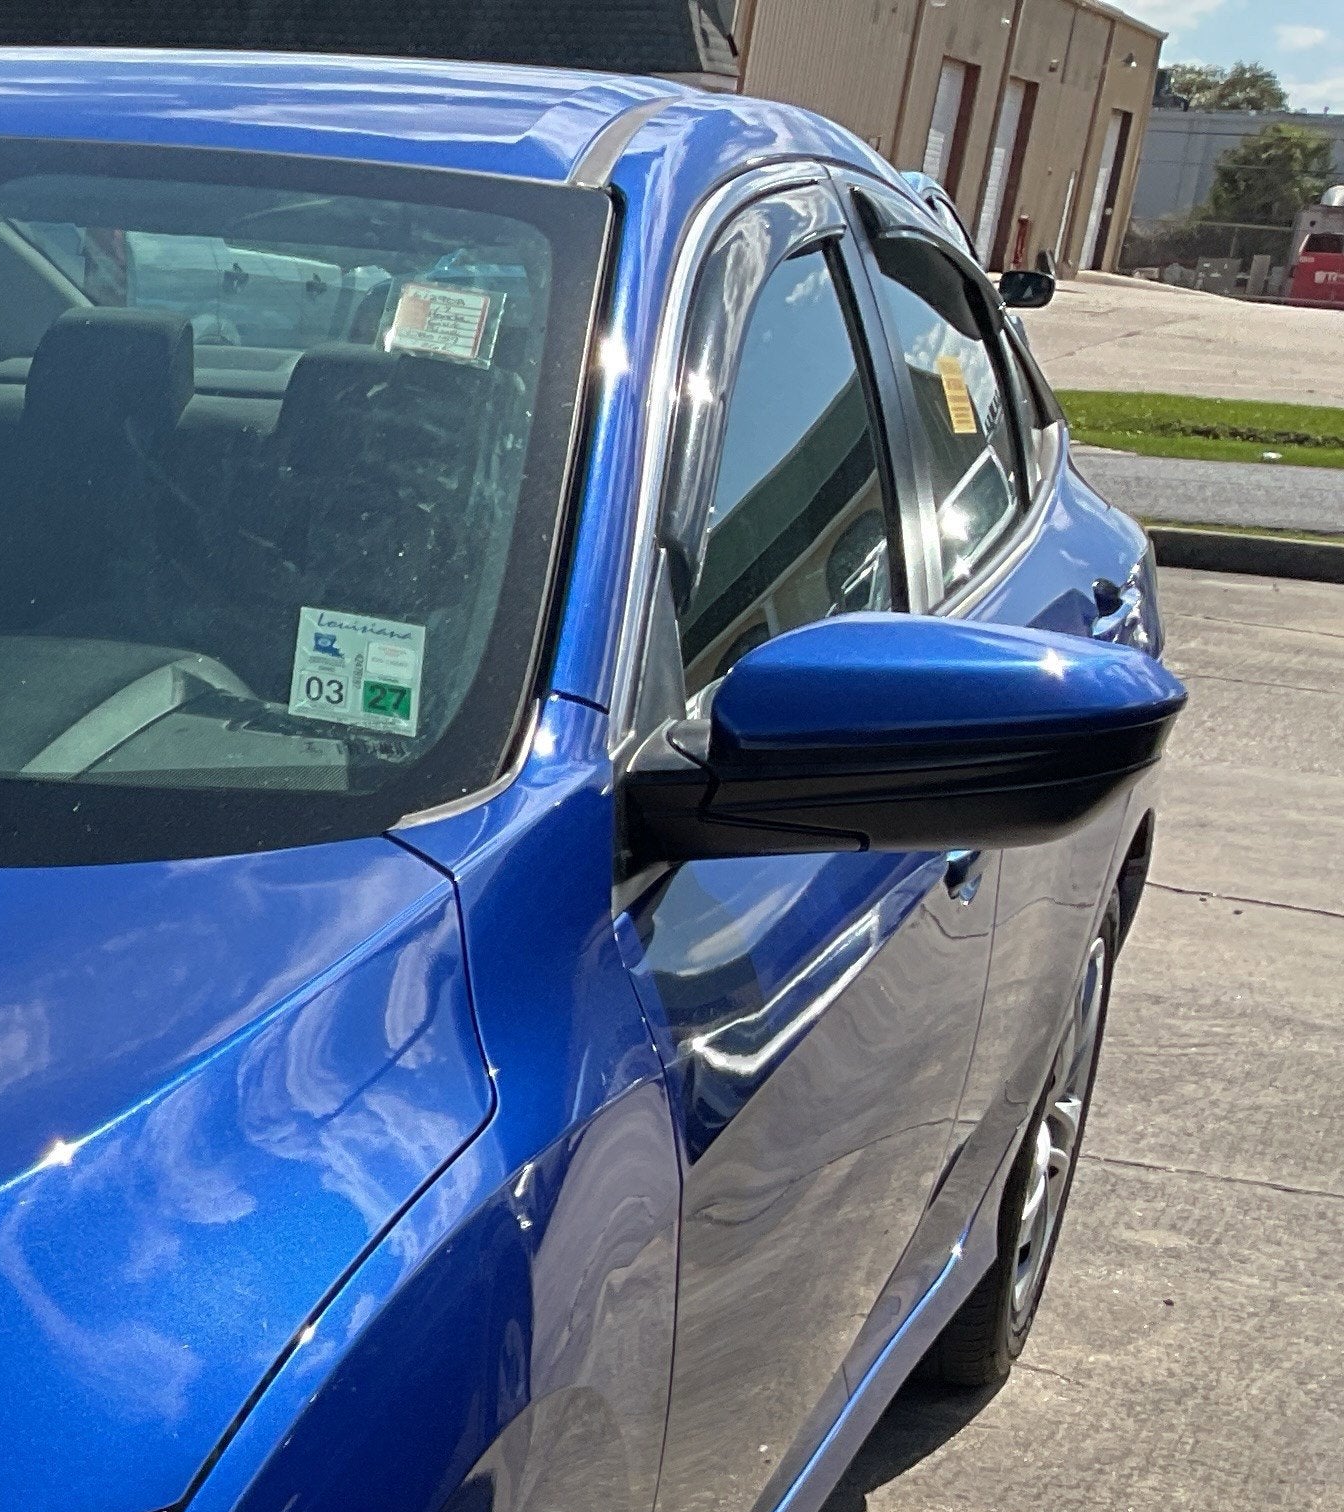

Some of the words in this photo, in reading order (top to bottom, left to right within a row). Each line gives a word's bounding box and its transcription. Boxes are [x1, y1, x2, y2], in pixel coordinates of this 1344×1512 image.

[318, 612, 412, 639] Louisiana
[305, 676, 344, 705] 03
[368, 685, 407, 711] 27
